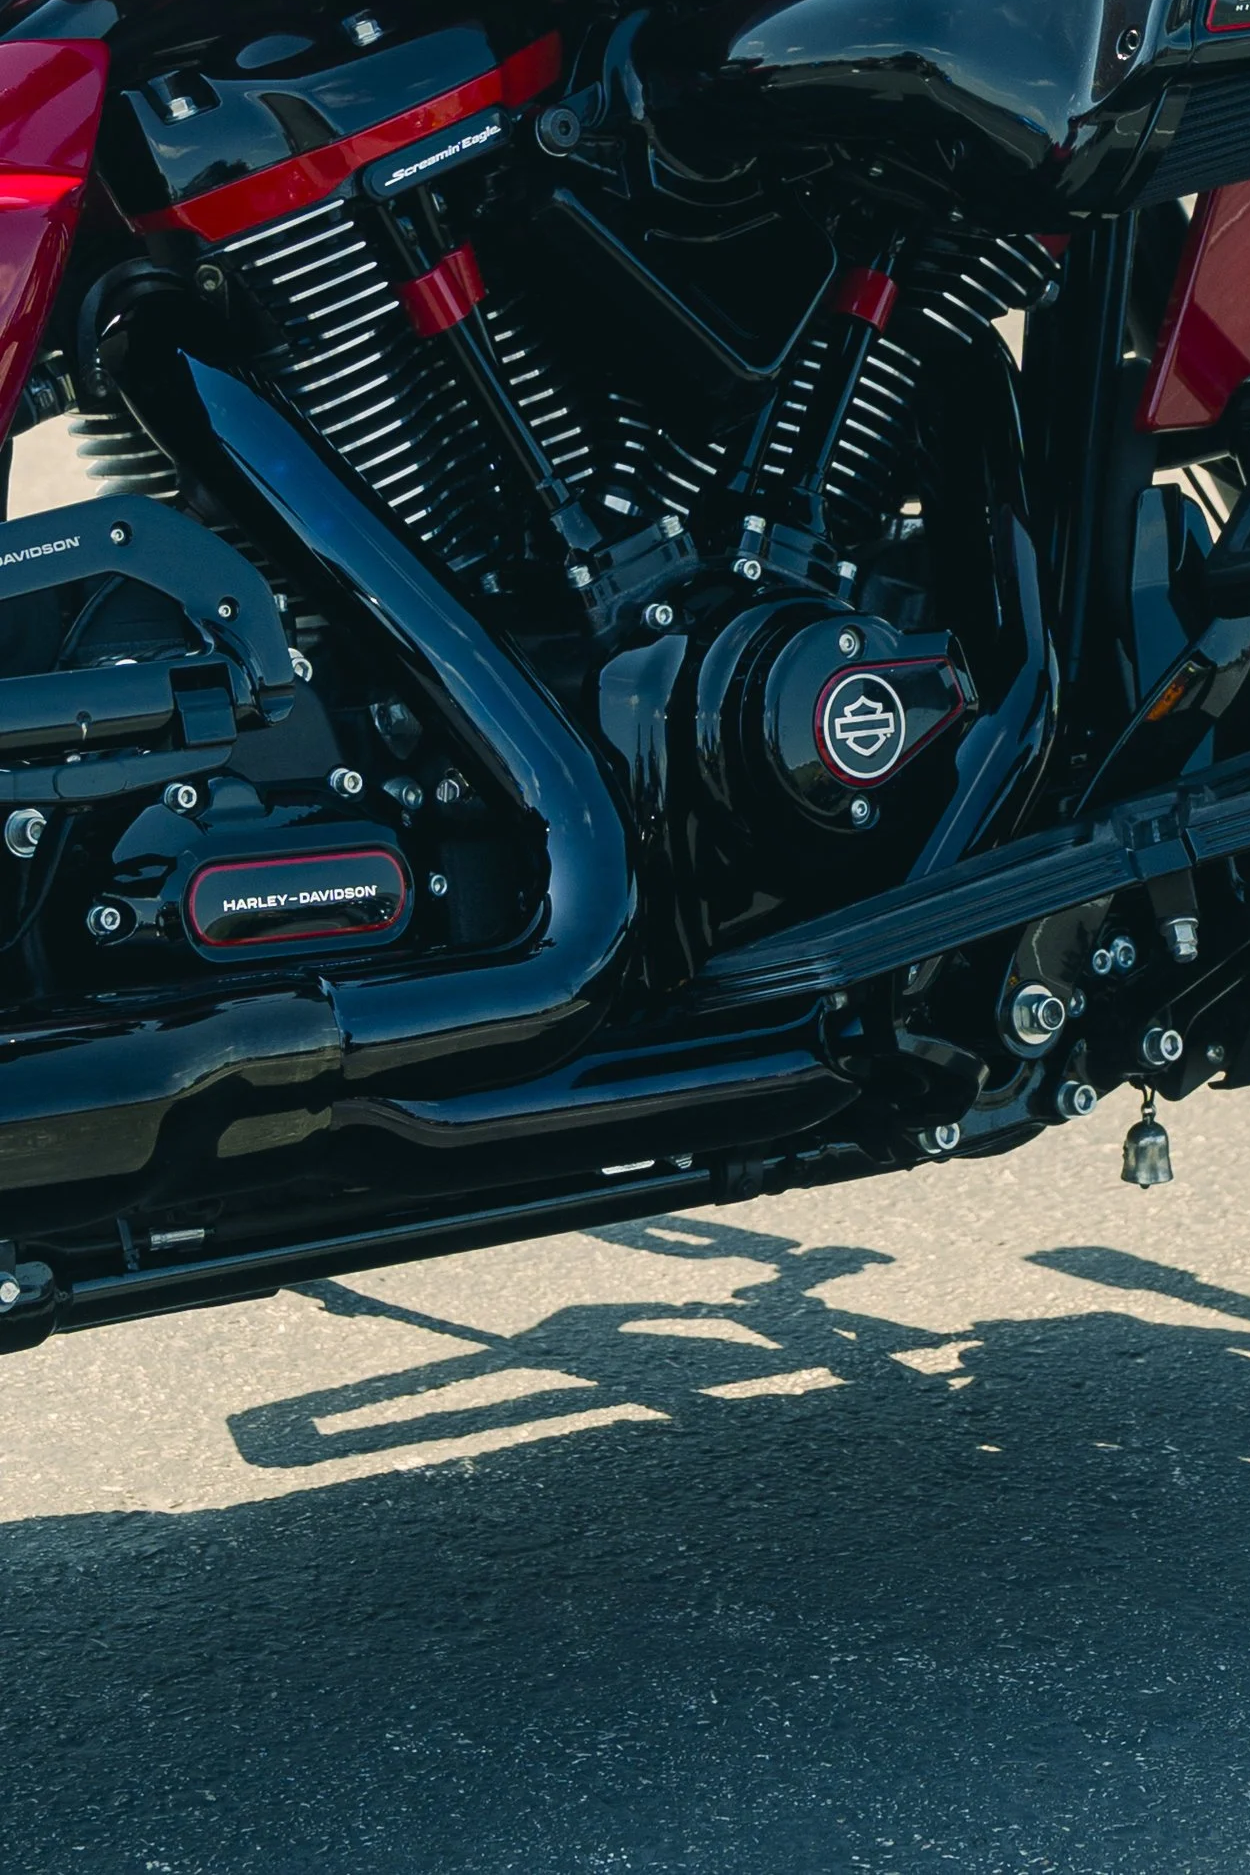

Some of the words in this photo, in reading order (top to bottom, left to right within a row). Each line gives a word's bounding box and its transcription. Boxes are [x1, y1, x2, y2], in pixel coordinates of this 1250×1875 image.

[384, 141, 461, 187] Screamin'
[461, 125, 501, 159] Eagle
[223, 884, 377, 912] HARLEY-DAVIDSON
